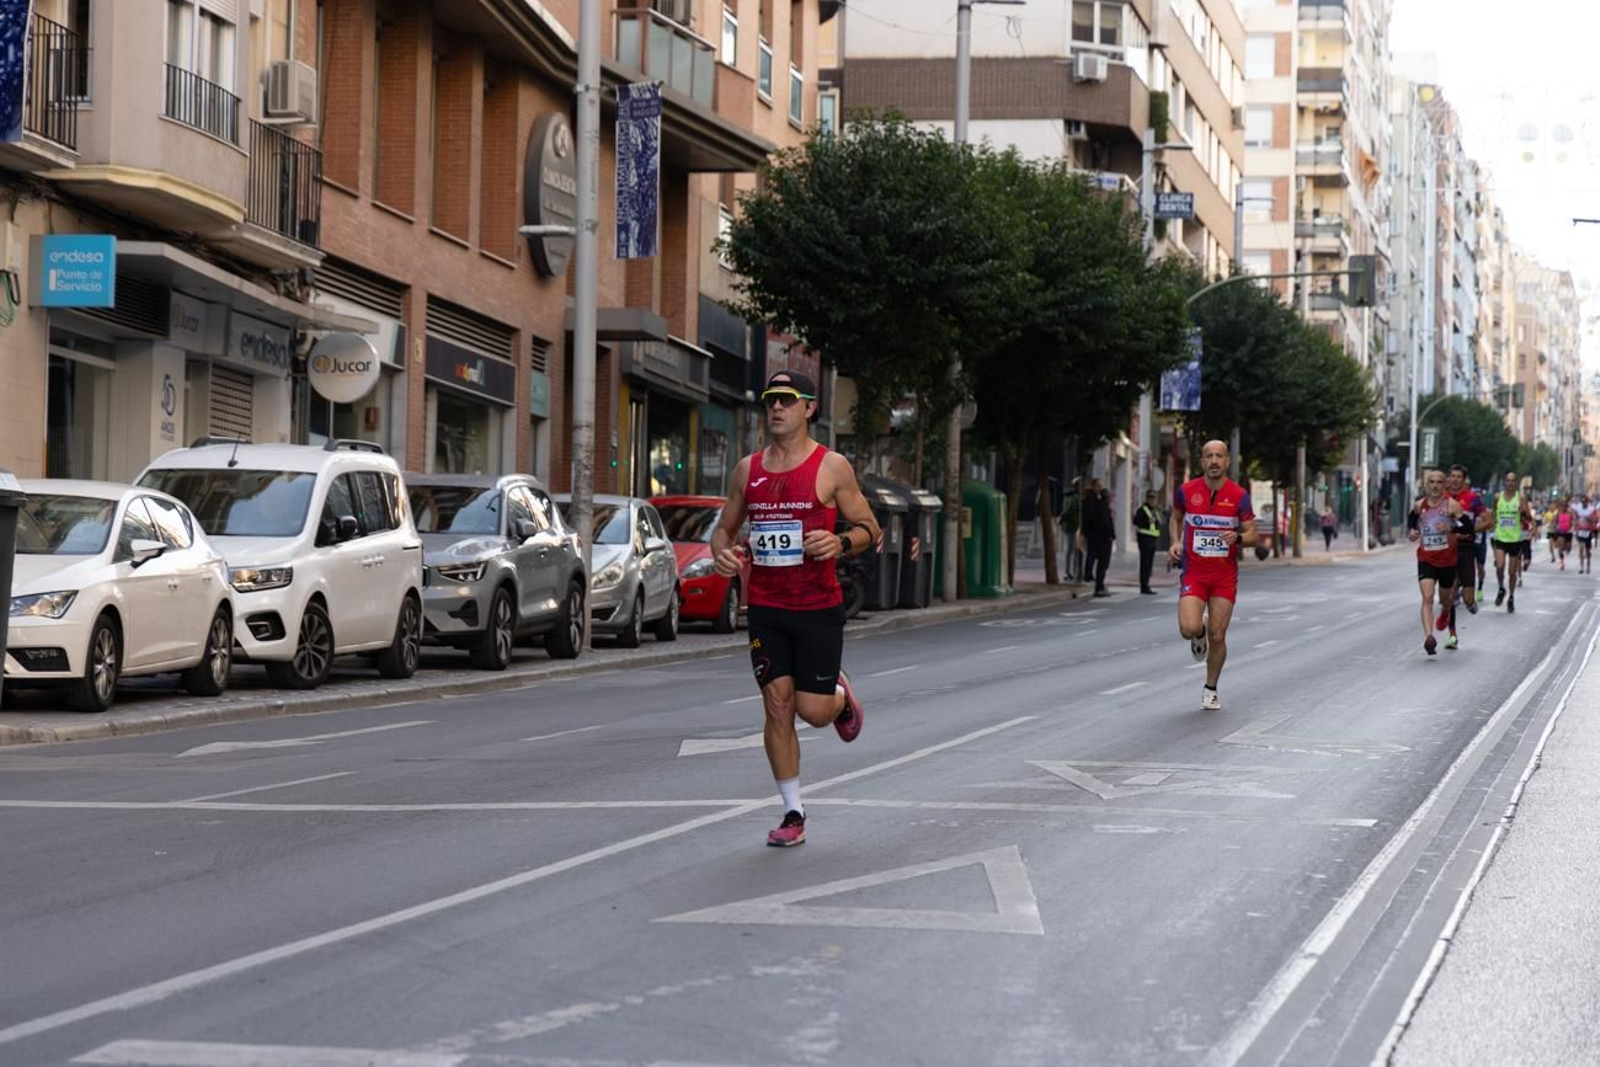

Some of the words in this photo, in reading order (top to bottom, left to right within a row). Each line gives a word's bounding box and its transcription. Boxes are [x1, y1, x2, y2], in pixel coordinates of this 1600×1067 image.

[1159, 202, 1191, 211] DENTAL
[49, 249, 104, 263] endesa
[57, 269, 87, 280] Punto
[89, 270, 103, 280] de
[57, 280, 103, 292] Servicio
[240, 330, 288, 369] endesa
[330, 357, 372, 374] Jucar
[757, 534, 791, 549] 419
[1201, 538, 1223, 547] 345
